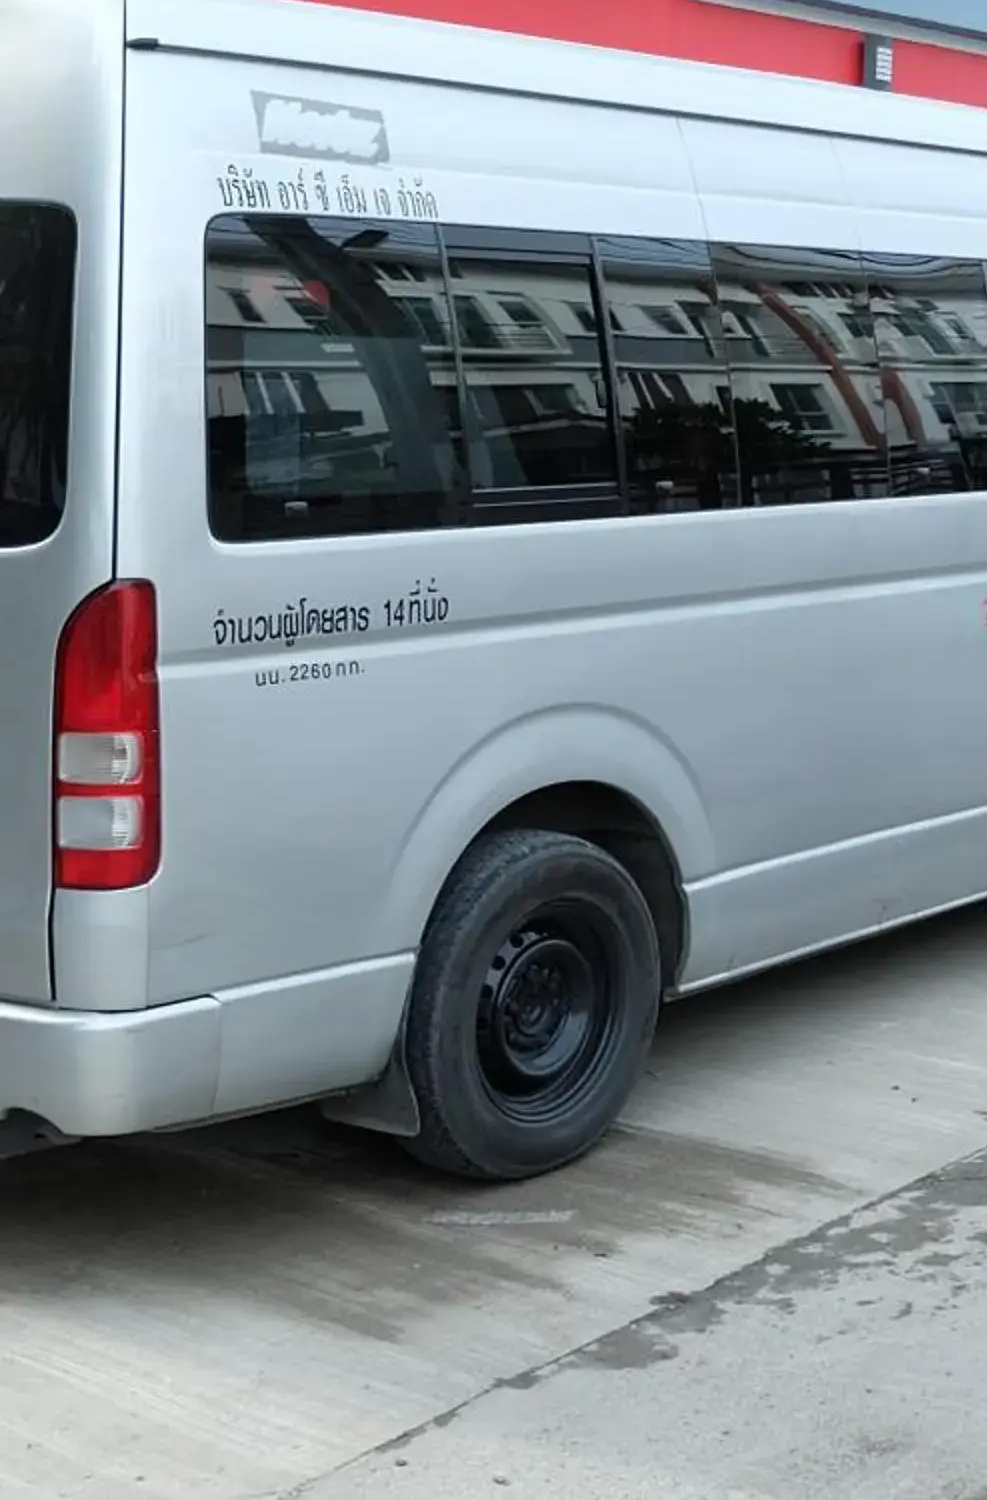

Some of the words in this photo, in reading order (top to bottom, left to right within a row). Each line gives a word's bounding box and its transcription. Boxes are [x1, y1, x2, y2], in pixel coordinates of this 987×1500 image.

[217, 163, 271, 208] บริษัท
[277, 167, 309, 210] อาร์
[336, 174, 367, 213] เอ็ม
[397, 176, 439, 219] จำกัด
[213, 597, 371, 647] จำนวนผู้โดยสาร
